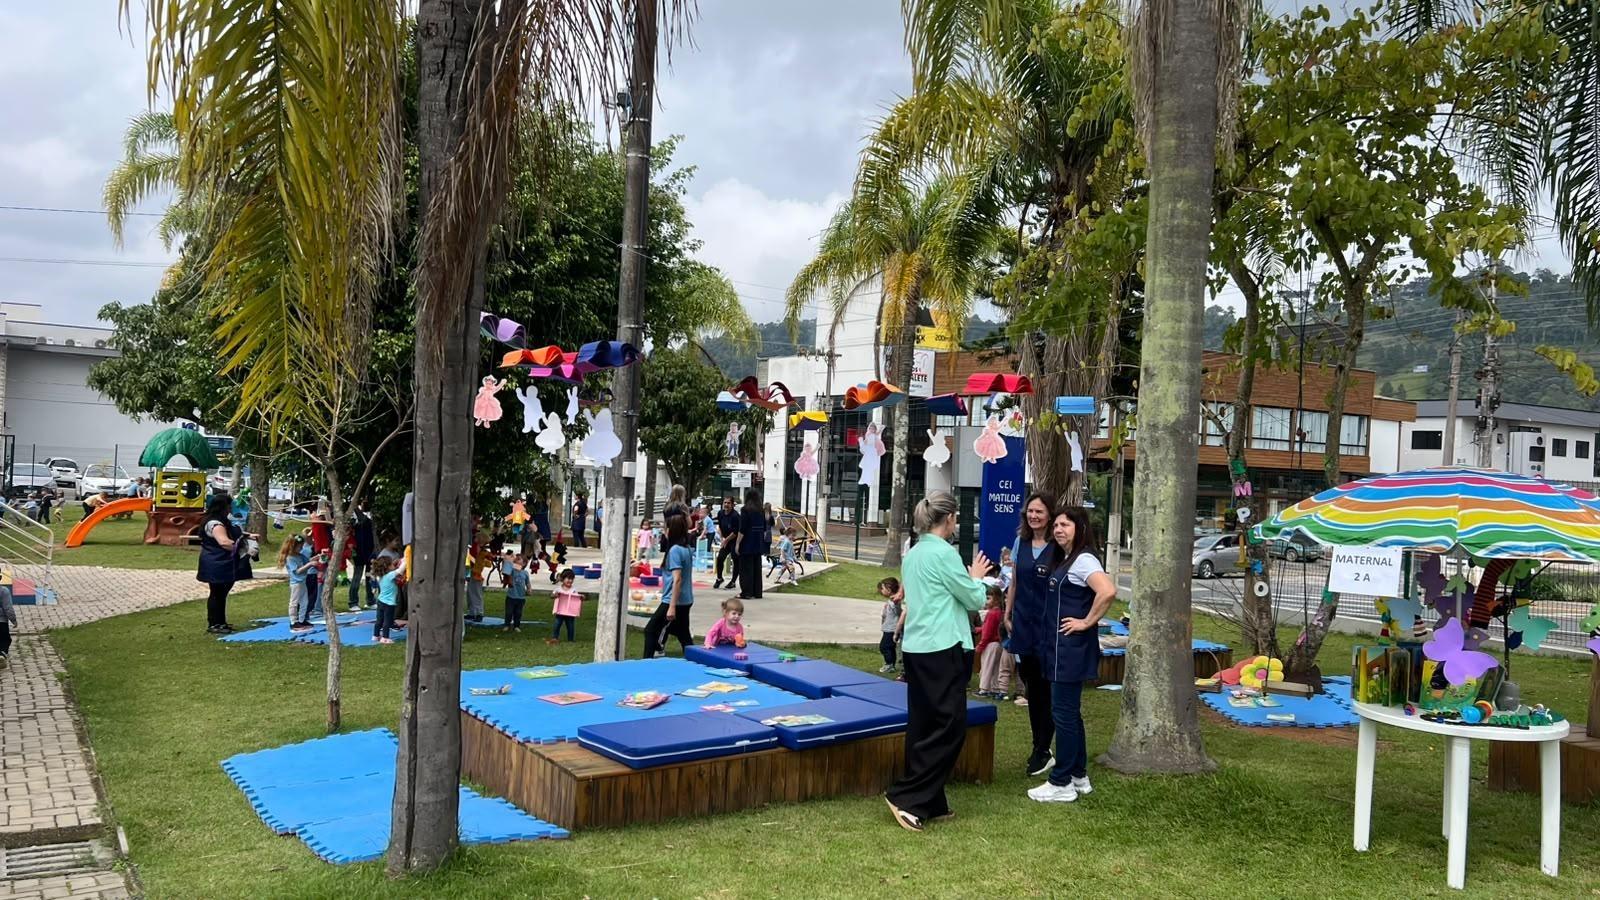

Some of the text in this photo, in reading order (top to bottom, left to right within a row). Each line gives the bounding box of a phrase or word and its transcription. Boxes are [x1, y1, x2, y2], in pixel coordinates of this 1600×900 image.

[998, 480, 1012, 489] CEI
[988, 493, 1020, 502] MATILDE
[994, 504, 1014, 513] SENS
[1335, 554, 1393, 567] MATERNAL
[1354, 573, 1371, 582] 2 A
